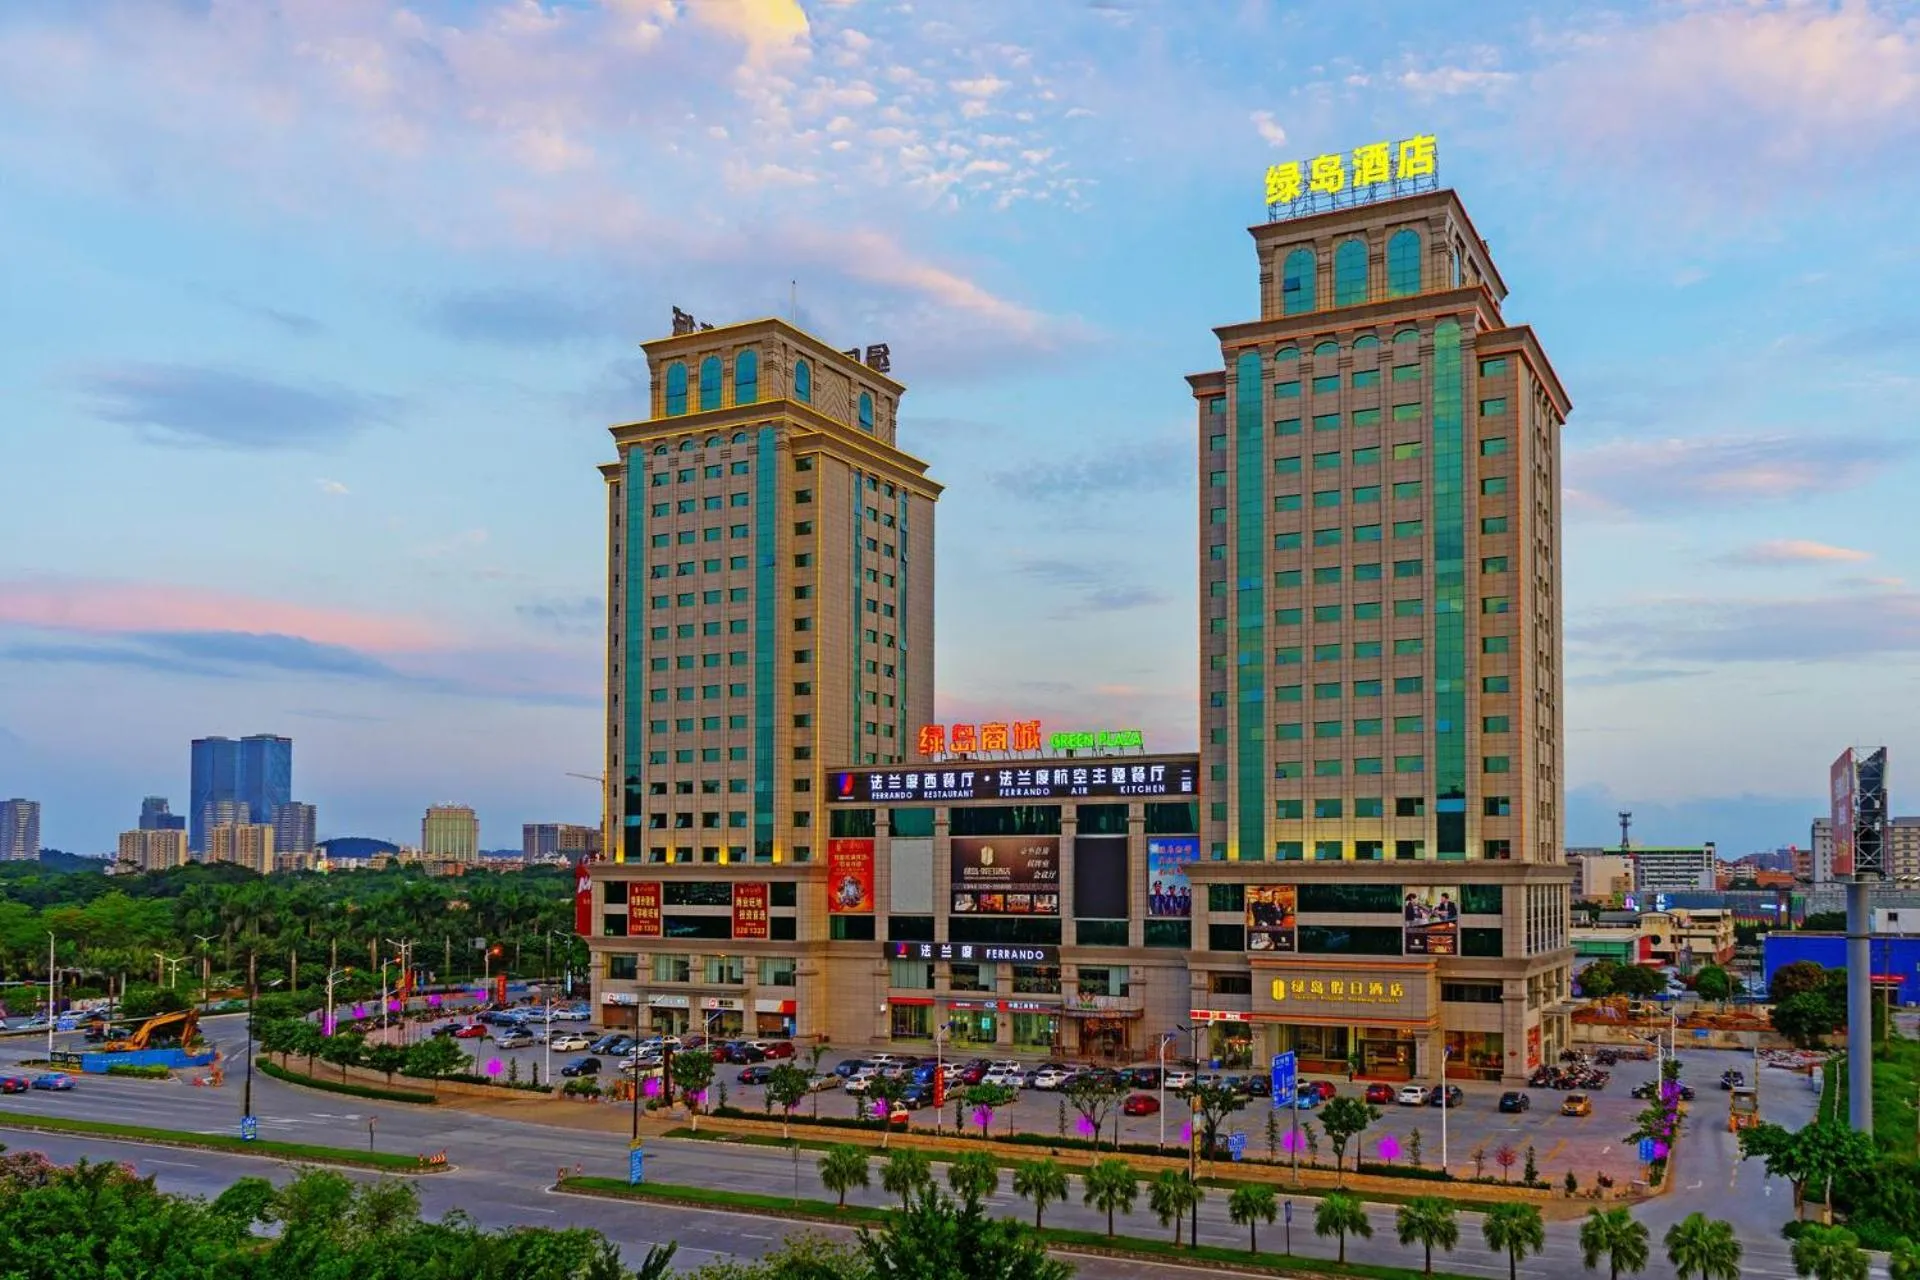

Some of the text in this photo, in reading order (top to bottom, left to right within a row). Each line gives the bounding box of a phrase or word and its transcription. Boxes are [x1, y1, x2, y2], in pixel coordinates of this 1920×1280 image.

[1264, 134, 1436, 205] 绿岛酒店
[918, 720, 1042, 754] 绿岛商城
[1051, 730, 1143, 748] GREEN PLAZA
[871, 789, 974, 800] FERRANDO RESTAURANT
[999, 784, 1166, 797] FERRANDO AIR KITCHEN
[986, 948, 1045, 960] FERRANDO
